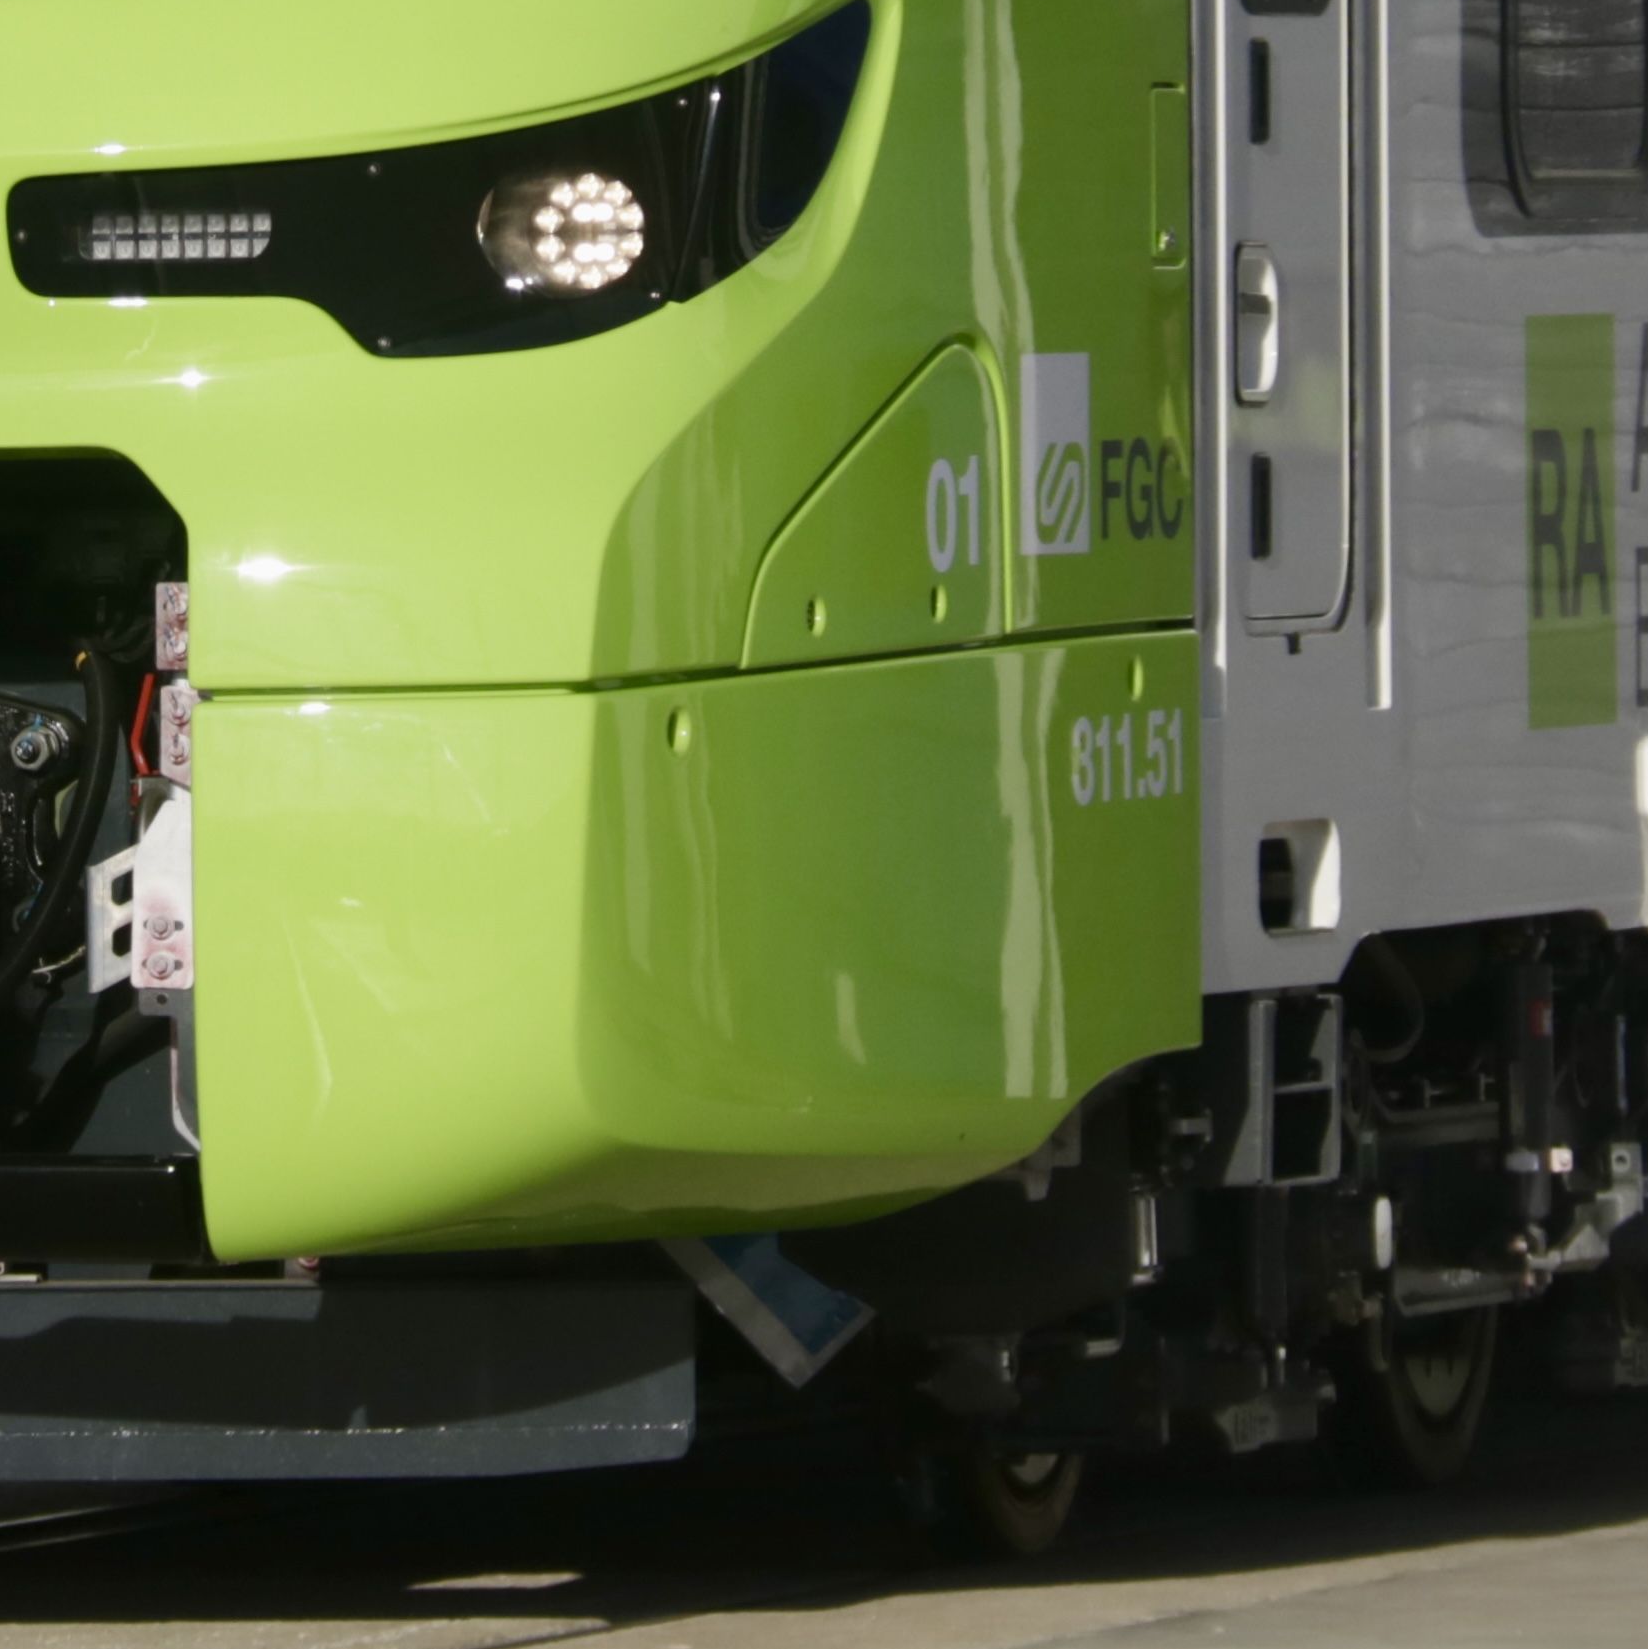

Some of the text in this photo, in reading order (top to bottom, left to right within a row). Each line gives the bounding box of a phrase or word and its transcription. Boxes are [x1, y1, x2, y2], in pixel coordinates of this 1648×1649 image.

[926, 454, 981, 573] 01
[1100, 436, 1185, 542] FGC
[1531, 426, 1612, 619] RA
[1071, 707, 1185, 807] 811.51
